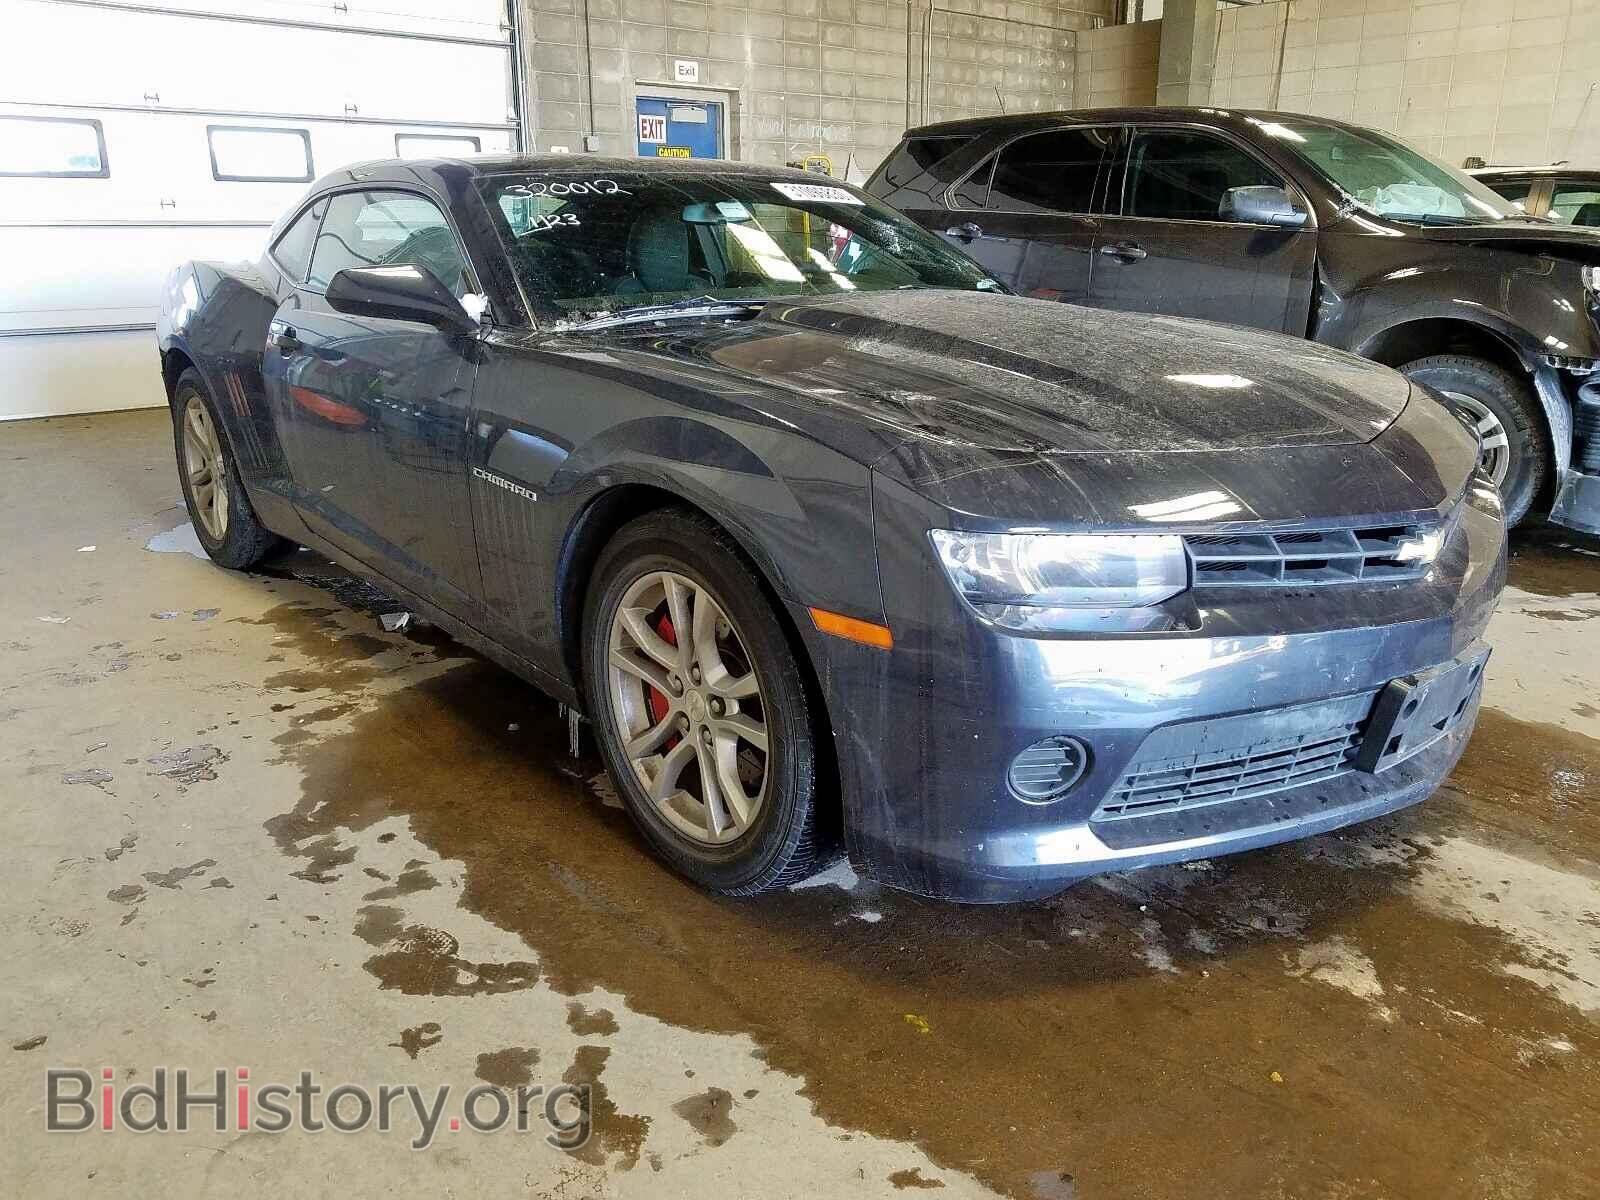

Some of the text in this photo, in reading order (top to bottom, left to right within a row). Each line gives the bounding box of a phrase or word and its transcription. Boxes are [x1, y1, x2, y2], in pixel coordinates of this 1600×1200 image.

[678, 65, 695, 77] Exit
[641, 118, 664, 140] EXIT
[658, 147, 690, 159] CAUTION
[505, 179, 633, 200] 320012
[472, 467, 537, 502] CAMARO
